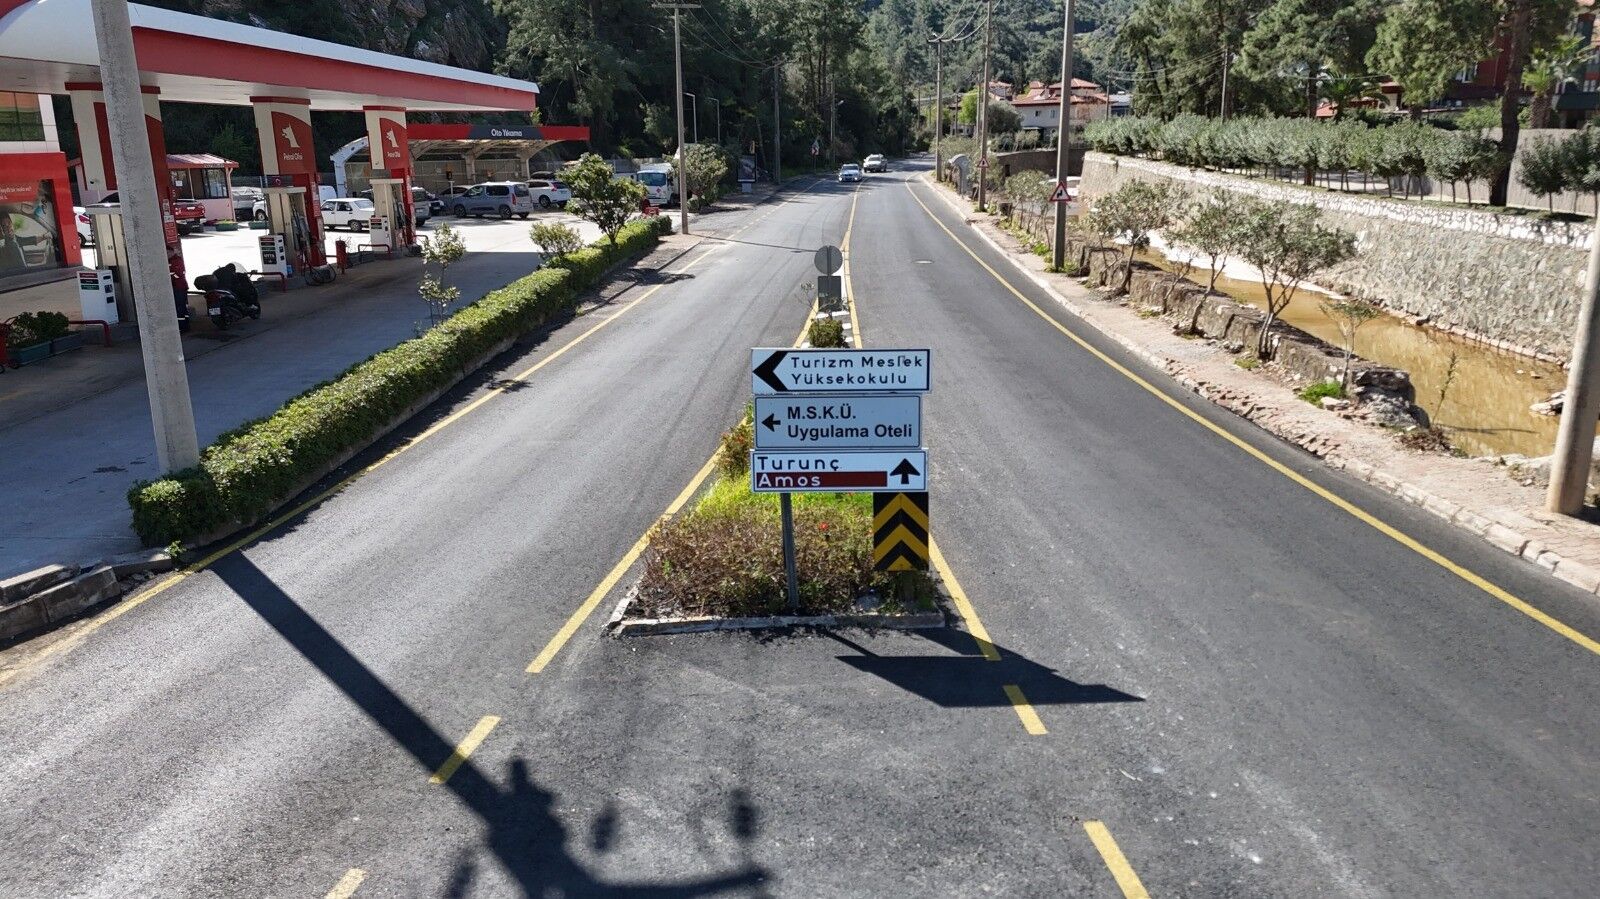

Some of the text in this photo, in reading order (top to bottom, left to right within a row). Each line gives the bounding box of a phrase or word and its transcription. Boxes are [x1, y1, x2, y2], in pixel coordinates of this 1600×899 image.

[491, 128, 502, 137] Oto
[791, 355, 923, 369] Turizm Meslek
[791, 373, 907, 385] Yüksekokulu
[787, 403, 857, 420] M.S.K.Ü.
[787, 423, 912, 441] Uygulama Oteli
[757, 456, 839, 471] Turunç
[758, 473, 821, 487] Amos
